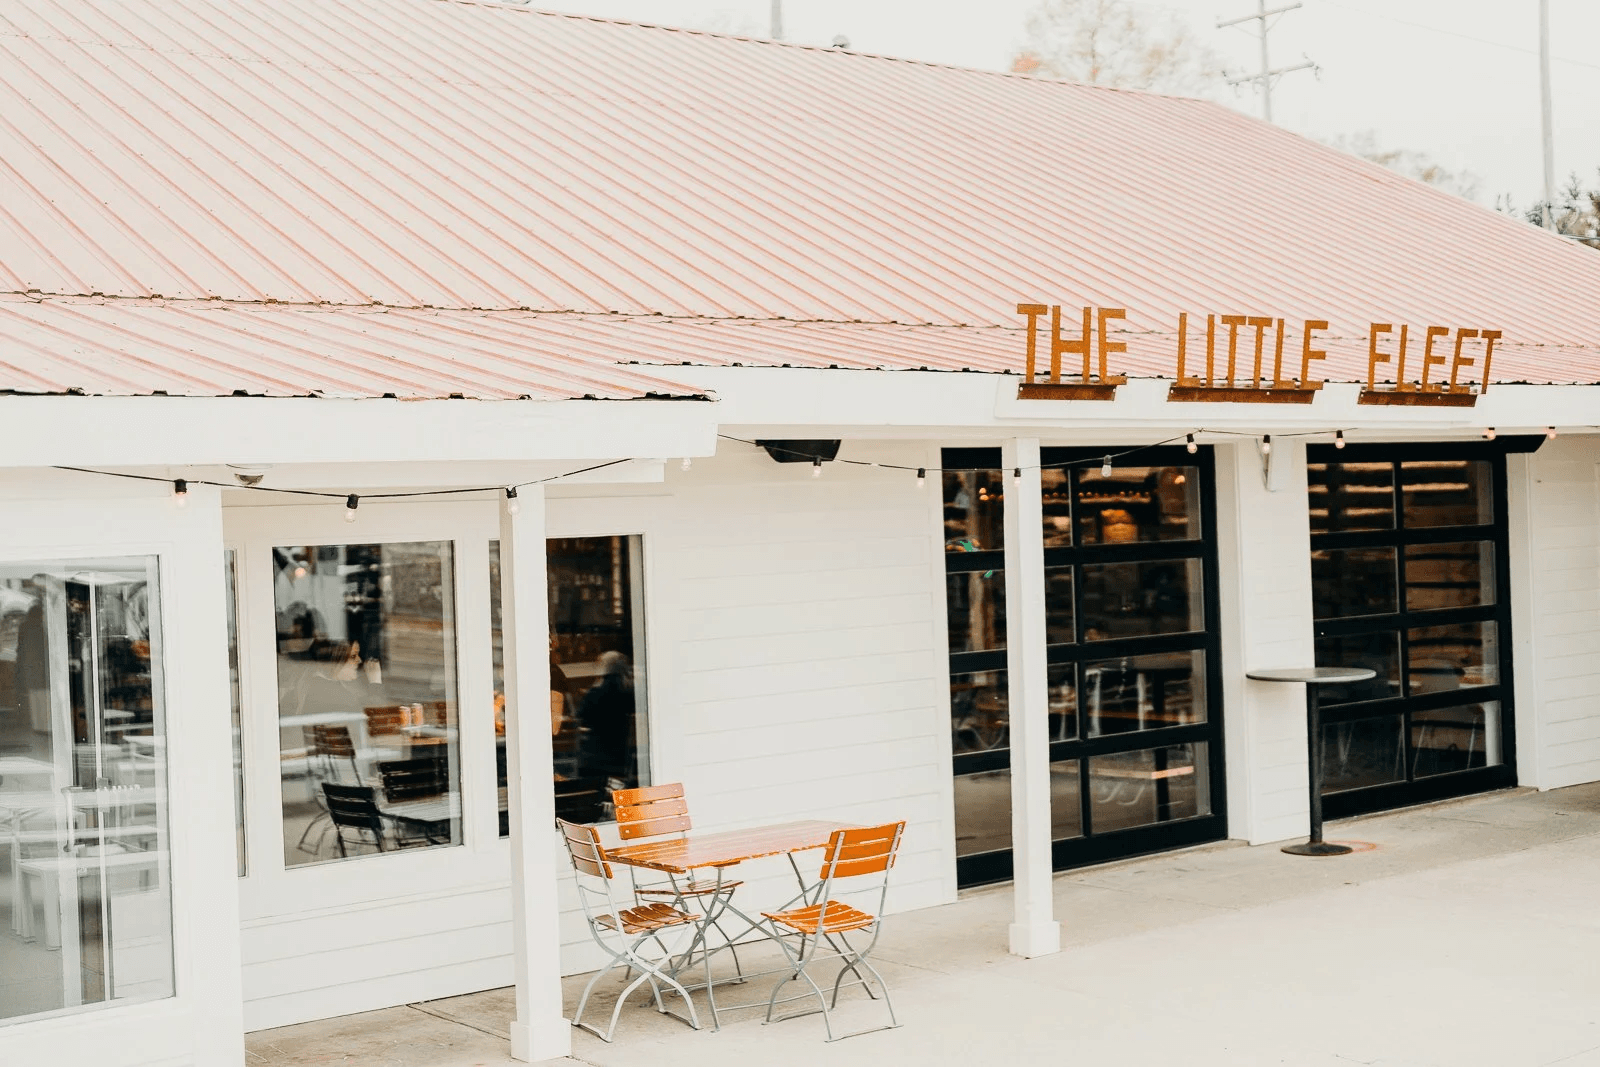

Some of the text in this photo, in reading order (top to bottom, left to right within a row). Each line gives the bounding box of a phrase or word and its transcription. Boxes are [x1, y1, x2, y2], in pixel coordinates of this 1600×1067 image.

[1017, 303, 1502, 394] THE LITTLE FLEET
